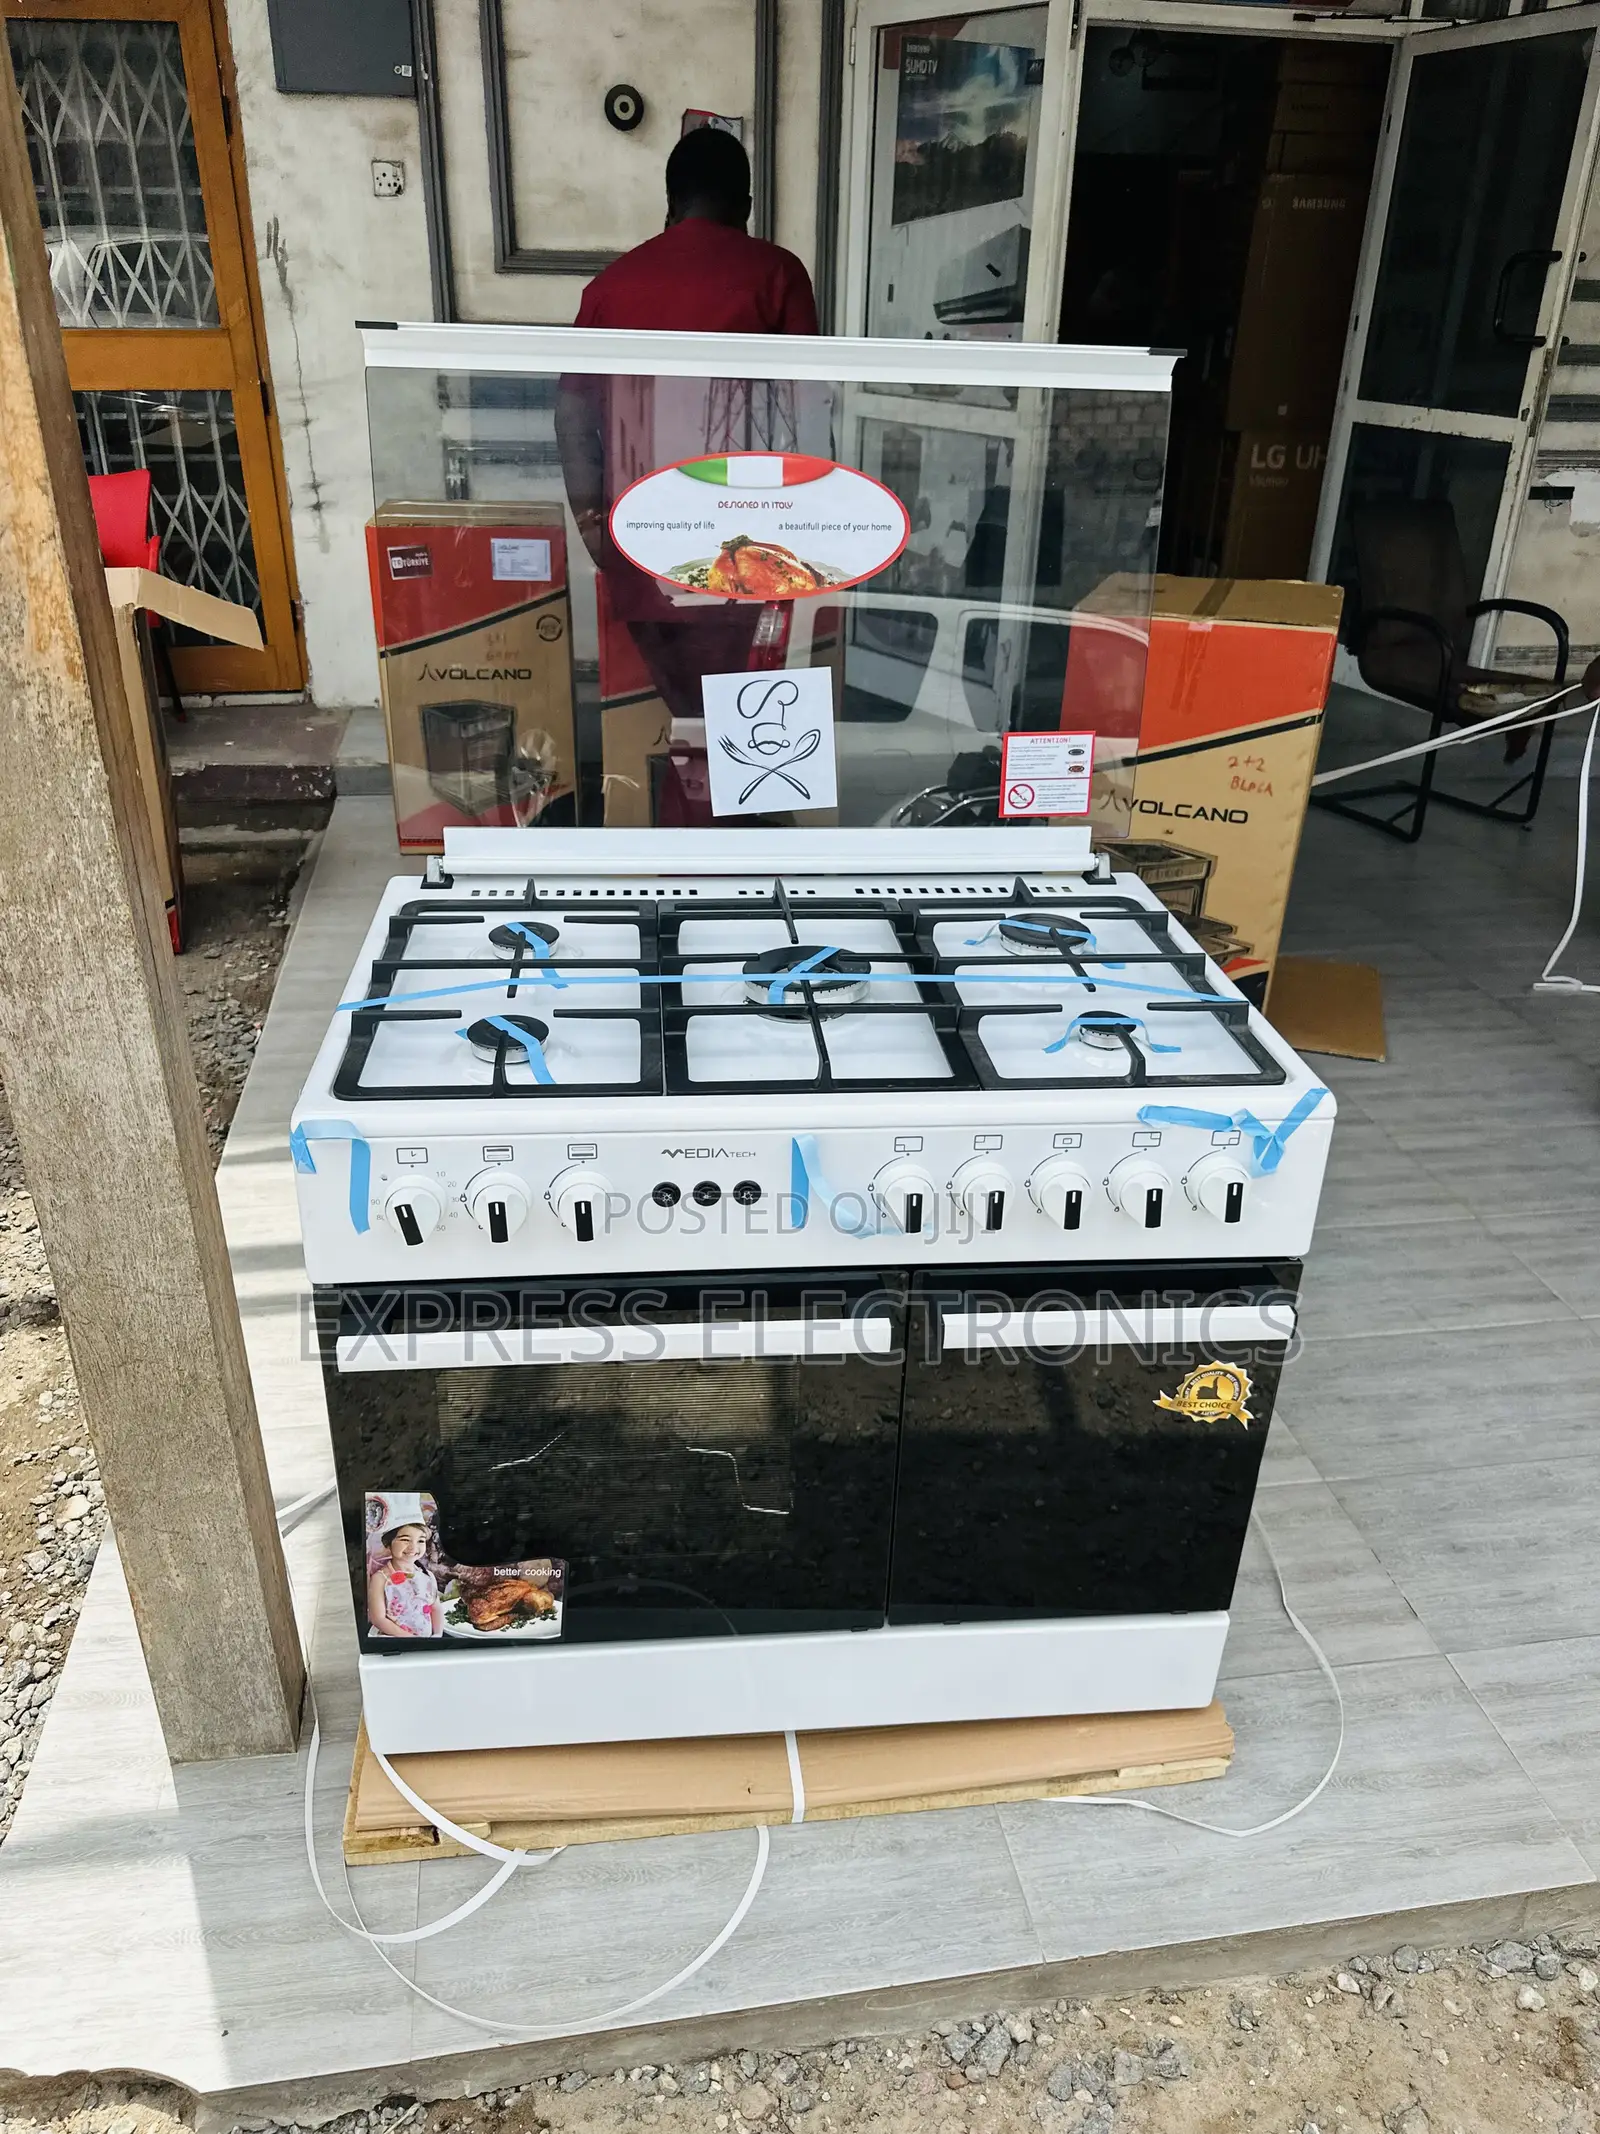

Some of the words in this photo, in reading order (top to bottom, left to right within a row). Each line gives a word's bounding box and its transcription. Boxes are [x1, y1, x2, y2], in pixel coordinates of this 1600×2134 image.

[1292, 197, 1346, 210] SAMSUNG
[1250, 444, 1287, 470] LG
[718, 501, 759, 509] DESIGNED
[626, 521, 664, 531] improving
[666, 521, 692, 531] quality
[694, 520, 702, 529] of
[703, 520, 715, 529] life
[785, 521, 820, 531] beautifull
[821, 522, 841, 532] piece
[843, 522, 851, 531] of
[852, 524, 870, 532] your
[871, 522, 892, 531] home
[436, 668, 532, 680] VOLCANO
[1122, 797, 1249, 824] VOLCANO
[493, 1567, 521, 1576] better
[525, 1567, 561, 1578] cooking
